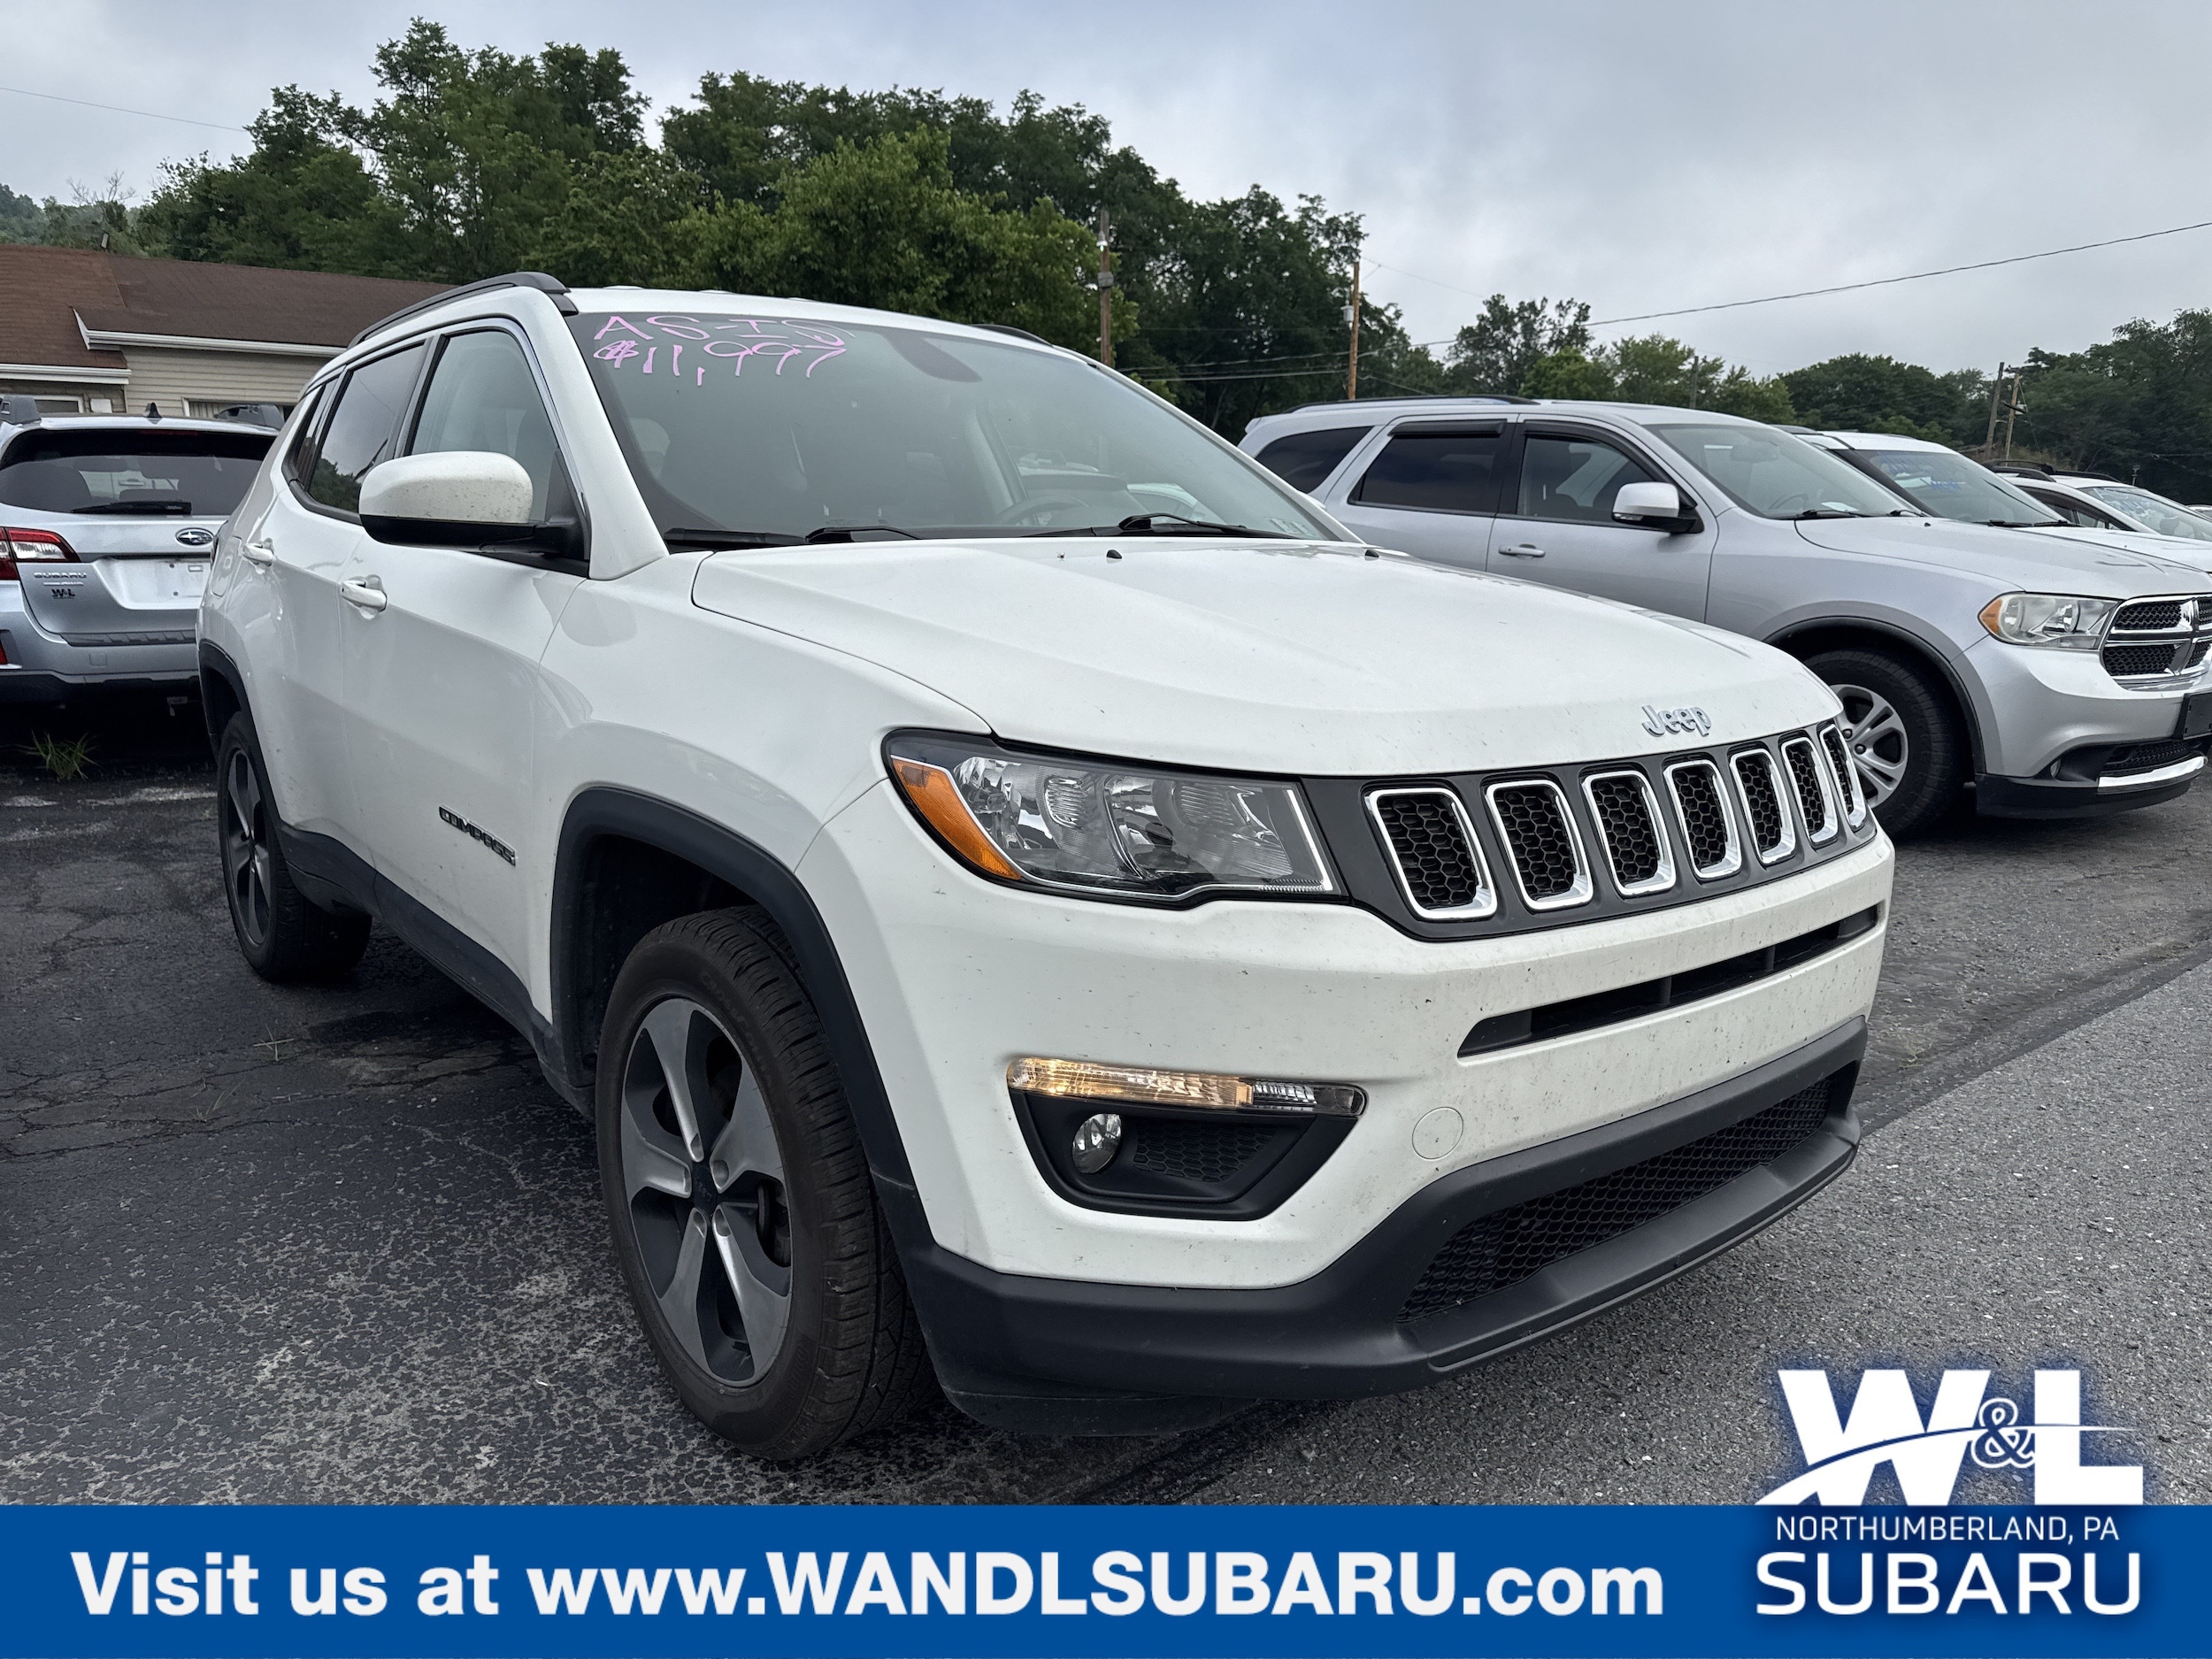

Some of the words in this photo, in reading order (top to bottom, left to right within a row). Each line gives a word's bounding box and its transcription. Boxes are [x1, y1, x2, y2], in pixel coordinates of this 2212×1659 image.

[594, 315, 856, 346] AS-IS
[593, 340, 847, 387] $11,997
[1641, 704, 1711, 737] Jeep
